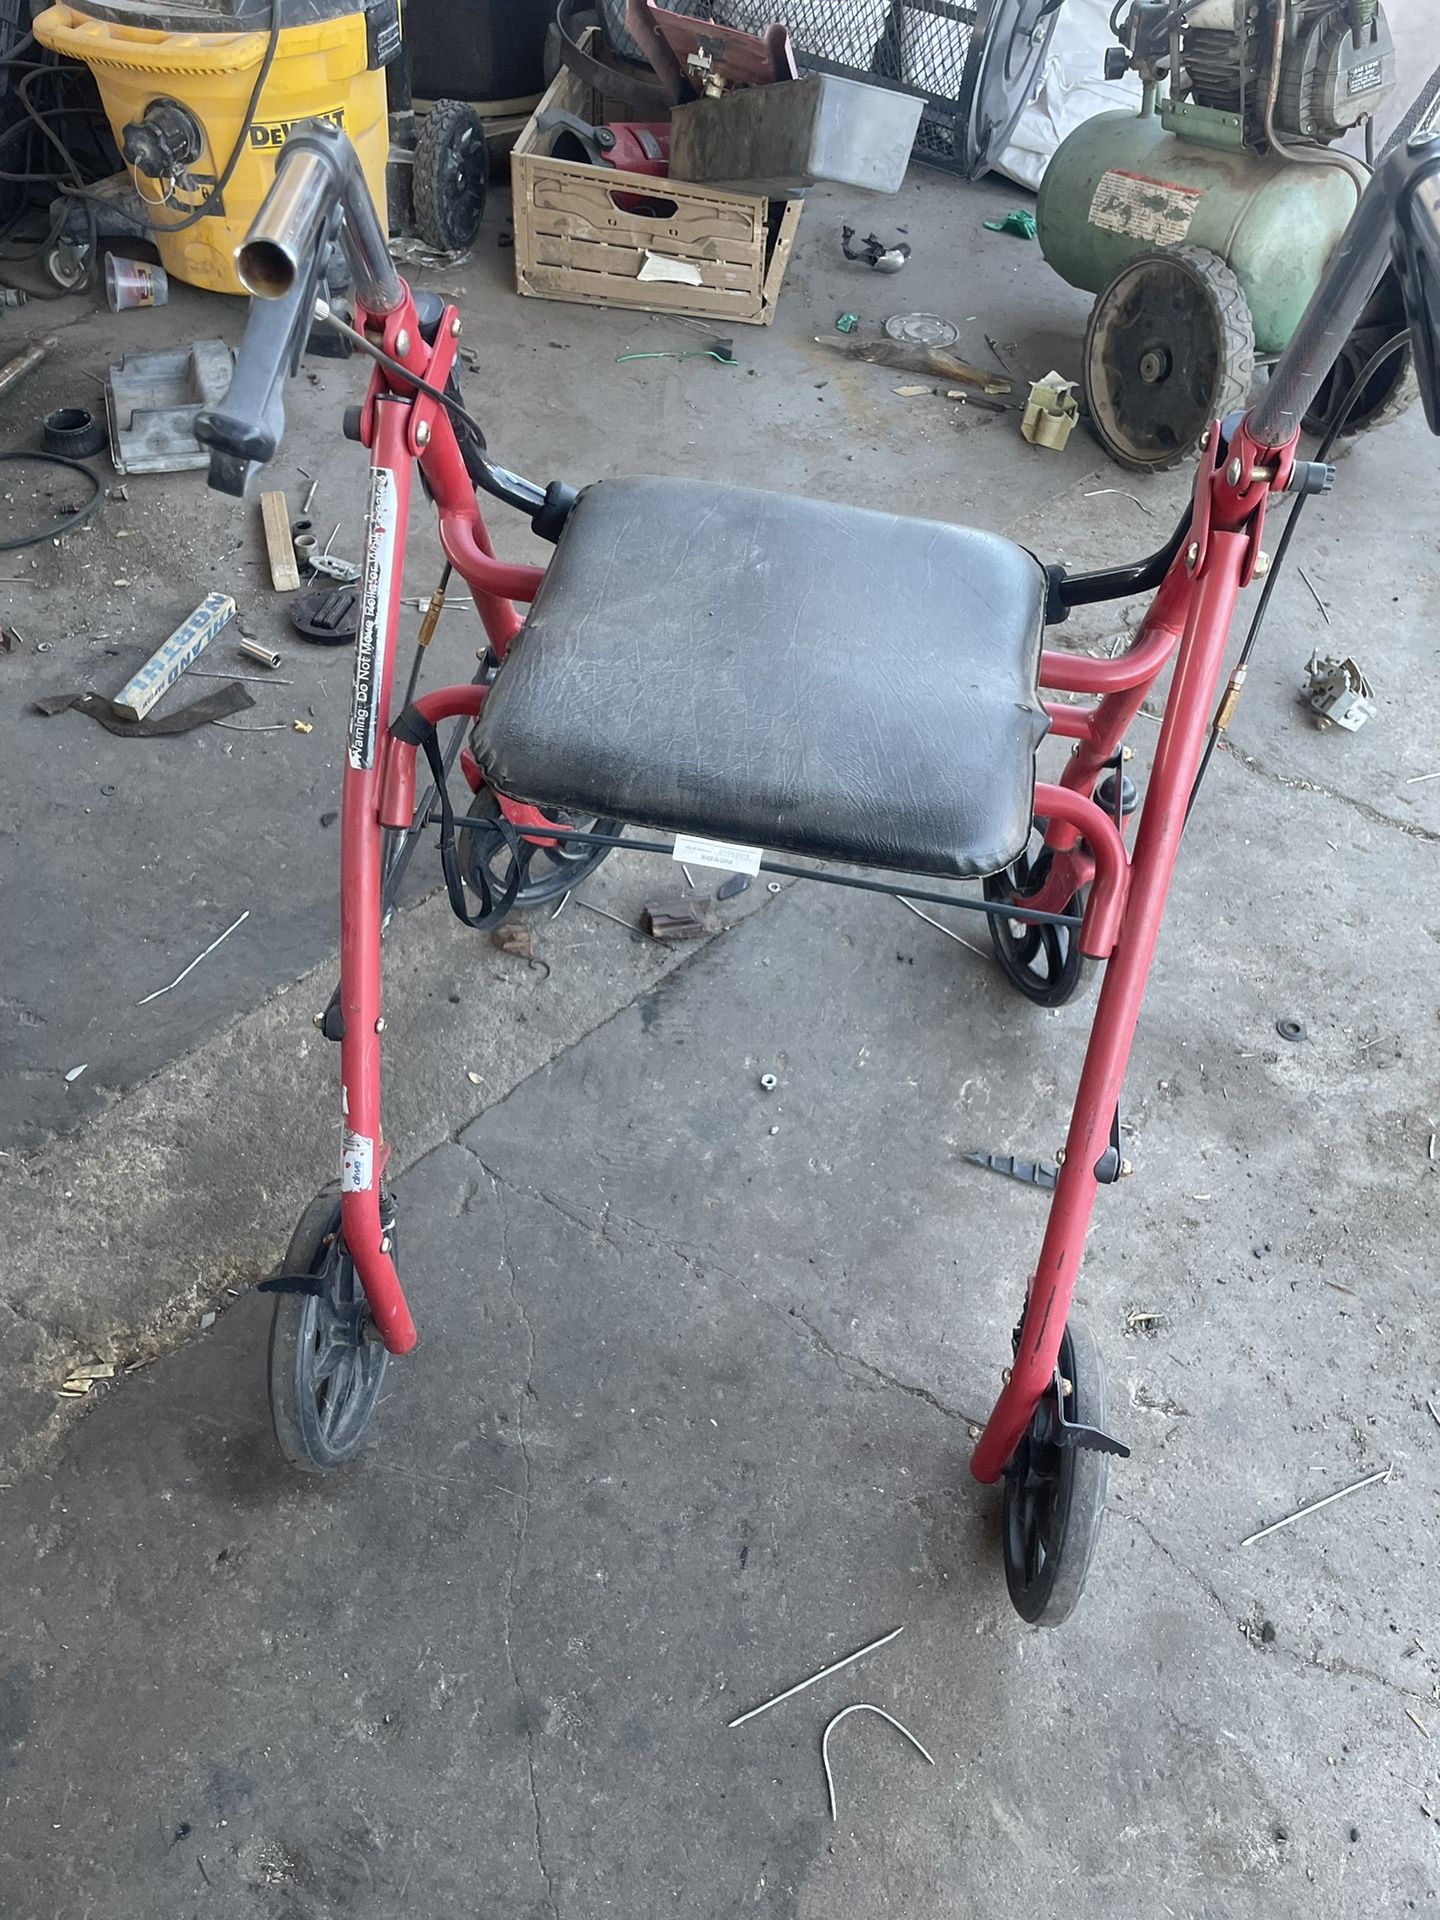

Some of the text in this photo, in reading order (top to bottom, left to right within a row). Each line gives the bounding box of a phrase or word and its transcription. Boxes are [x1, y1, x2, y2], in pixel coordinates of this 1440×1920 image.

[361, 619, 375, 654] Move
[359, 655, 371, 681] Not
[357, 683, 369, 701] Do
[351, 705, 370, 759] Warning:
